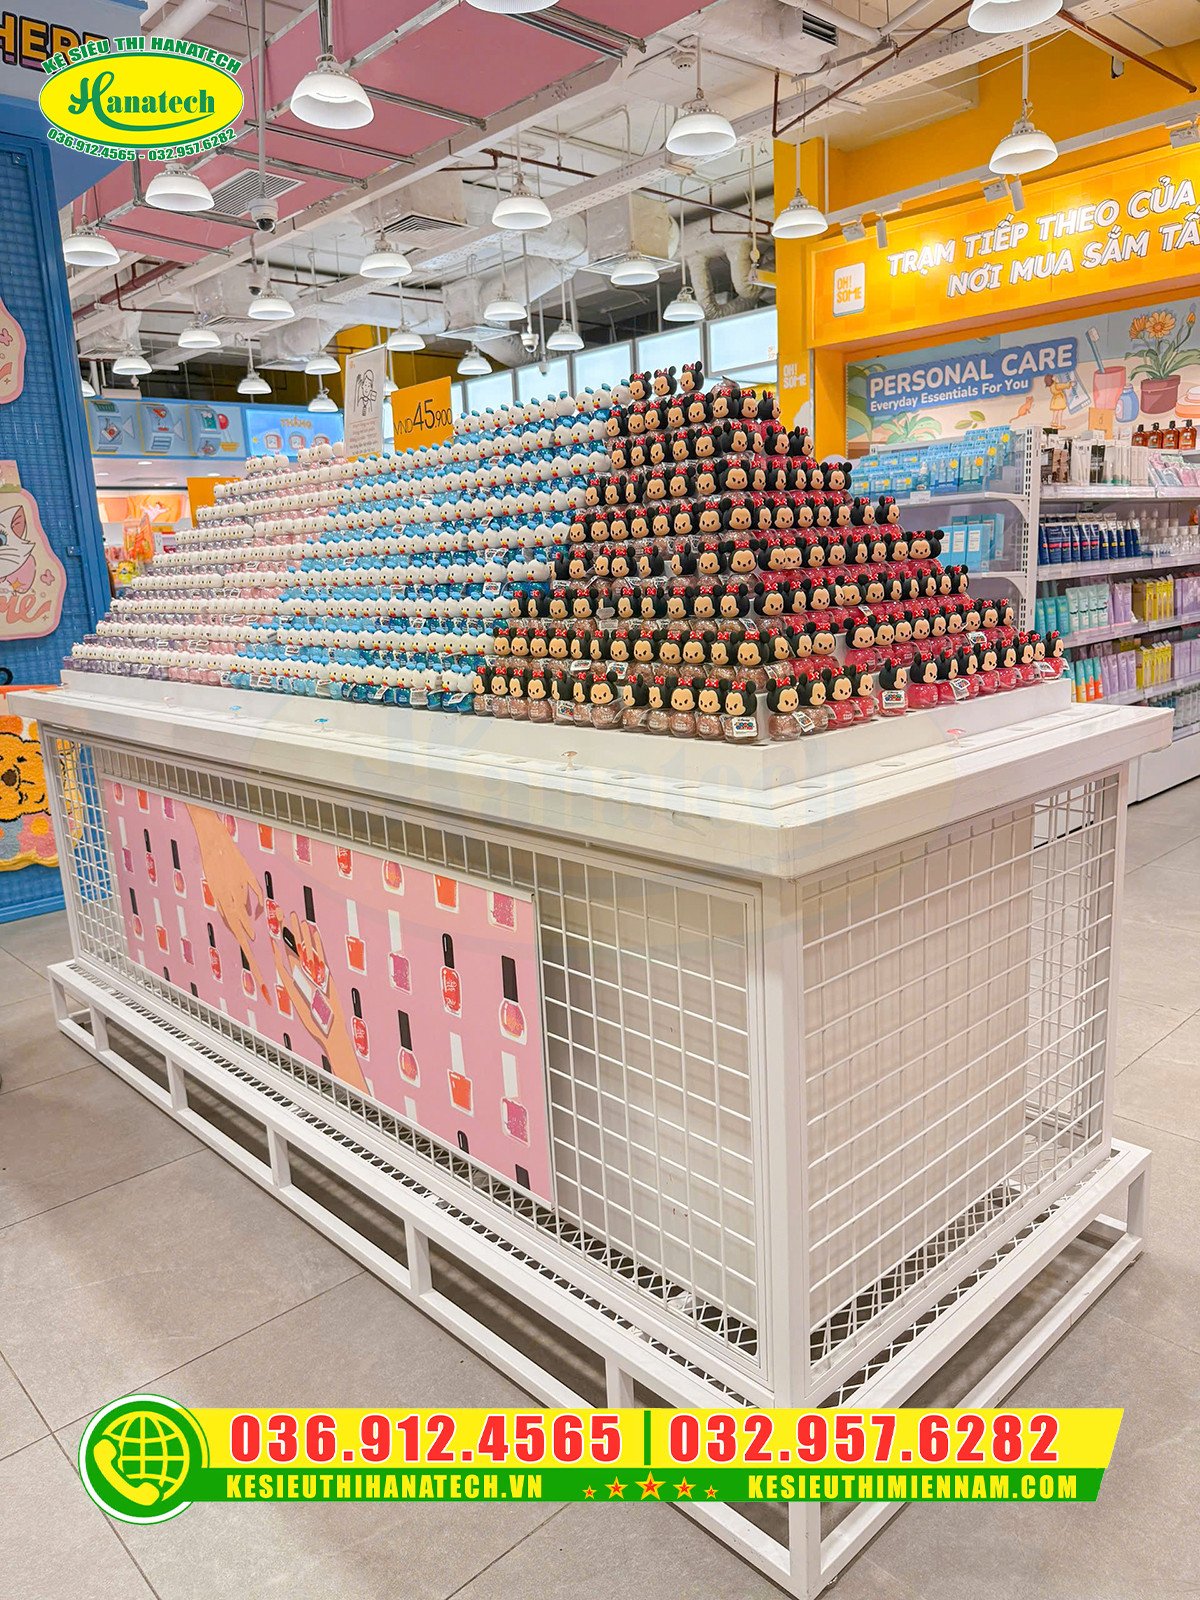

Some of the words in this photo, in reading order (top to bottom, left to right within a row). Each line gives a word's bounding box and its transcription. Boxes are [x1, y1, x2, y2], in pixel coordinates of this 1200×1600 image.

[887, 239, 956, 276] TRẠM
[963, 212, 1029, 259] TIẾP
[1036, 199, 1120, 241] THEO
[1127, 175, 1197, 219] CỦA
[947, 262, 1003, 298] NƠI
[1008, 249, 1075, 285] MUA
[1080, 225, 1151, 269] SẮM
[870, 356, 993, 399] PERSONAL
[1001, 343, 1074, 377] CARE
[870, 394, 919, 412] Everyday
[921, 386, 978, 404] Essentials
[982, 380, 1002, 395] For
[1005, 377, 1029, 392] You
